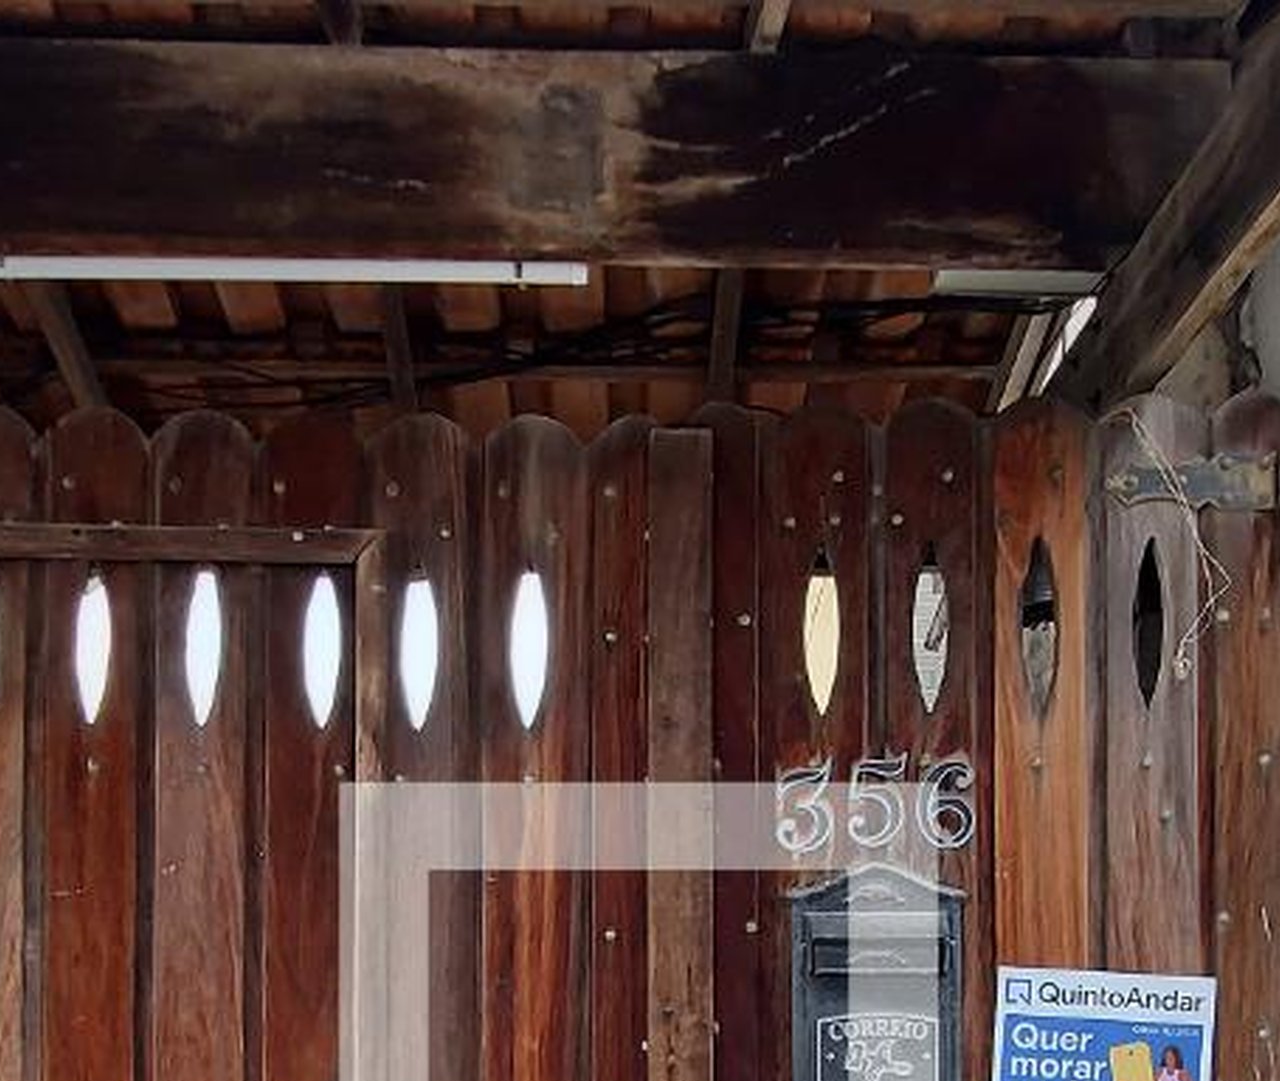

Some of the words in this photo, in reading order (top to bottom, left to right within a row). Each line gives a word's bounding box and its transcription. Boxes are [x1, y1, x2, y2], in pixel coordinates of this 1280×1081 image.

[776, 752, 976, 856] 356
[1038, 981, 1205, 1013] QuintoAndar
[828, 1018, 930, 1042] CORREIO
[1012, 1023, 1093, 1052] Quer
[1010, 1055, 1107, 1081] morar
